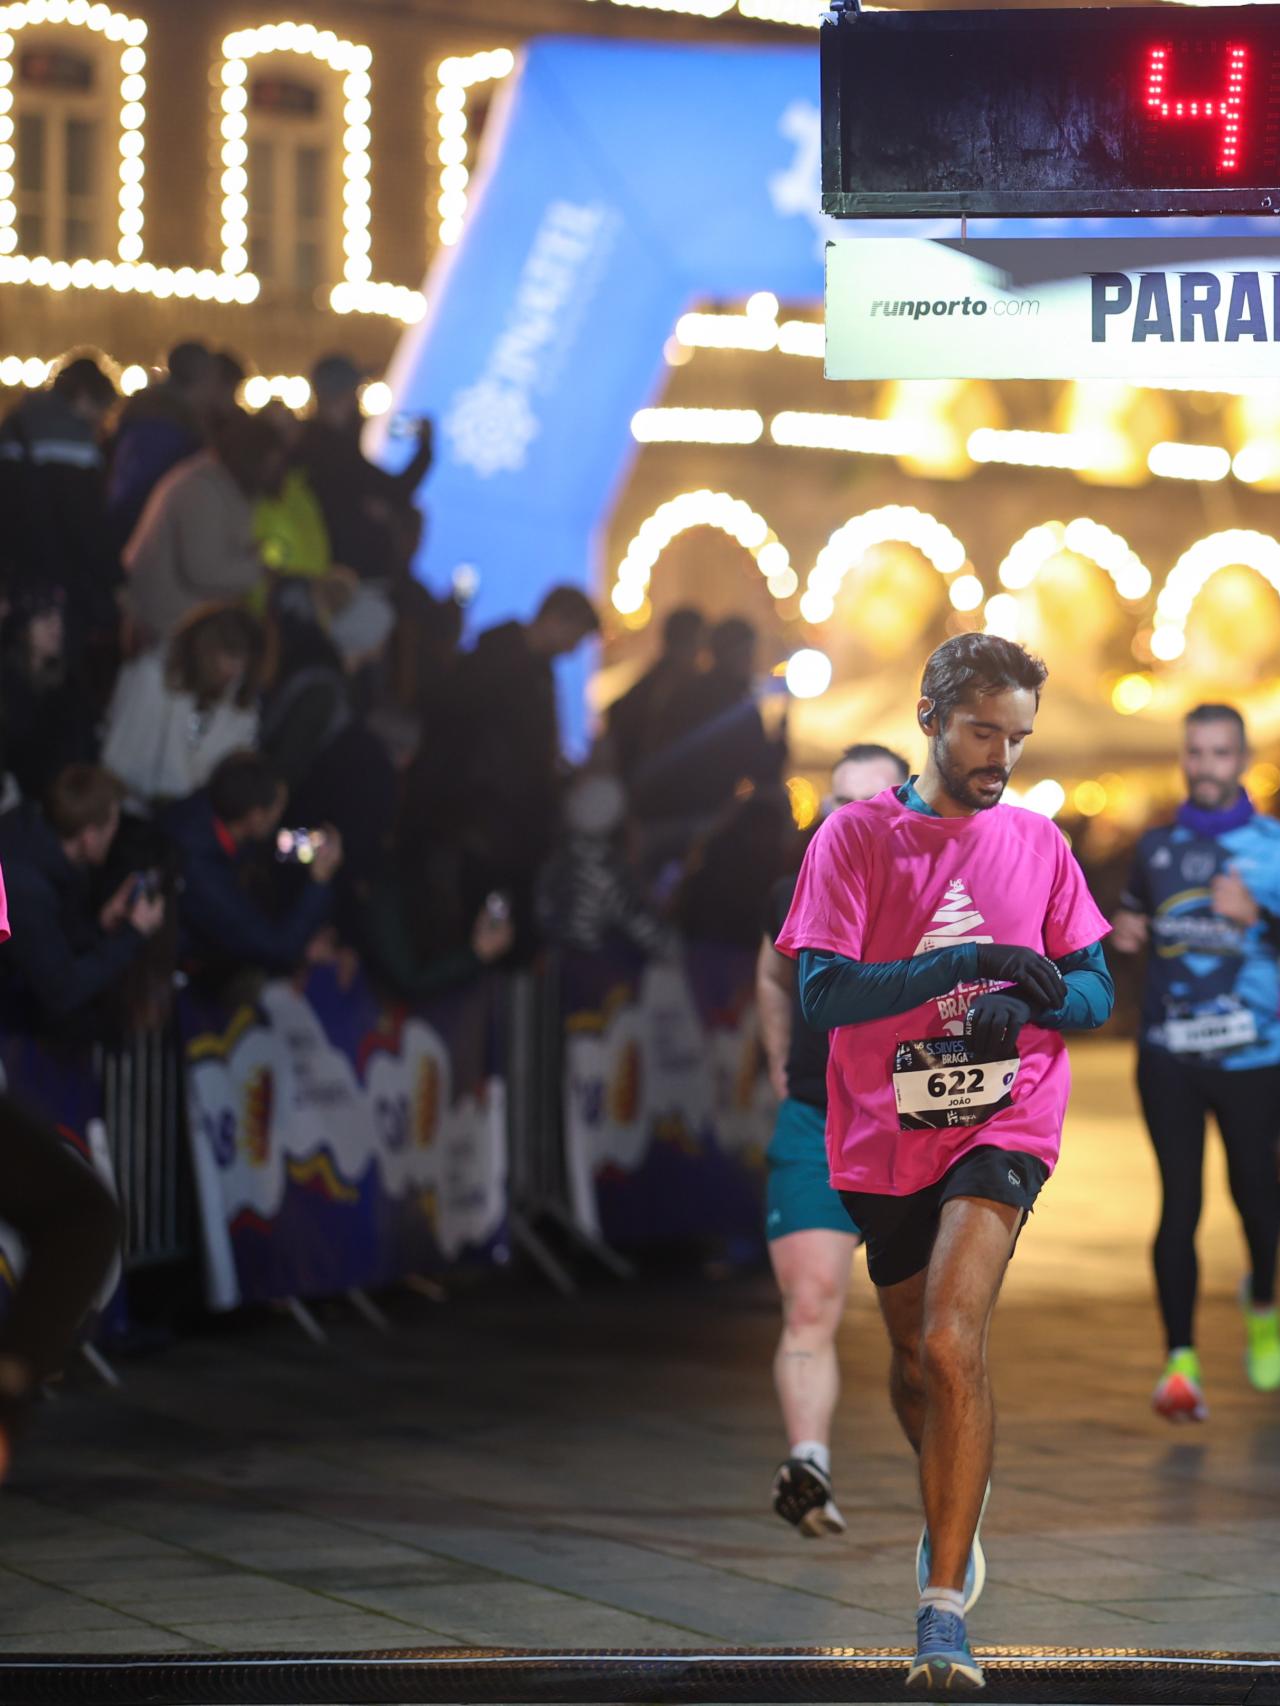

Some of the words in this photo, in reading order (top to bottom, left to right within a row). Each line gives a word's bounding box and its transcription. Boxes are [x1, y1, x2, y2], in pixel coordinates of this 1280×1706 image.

[965, 1008, 976, 1036] KIPSTA
[942, 1052, 969, 1065] BRAGA
[927, 1068, 985, 1098] 622
[948, 1097, 971, 1107] JOÃO
